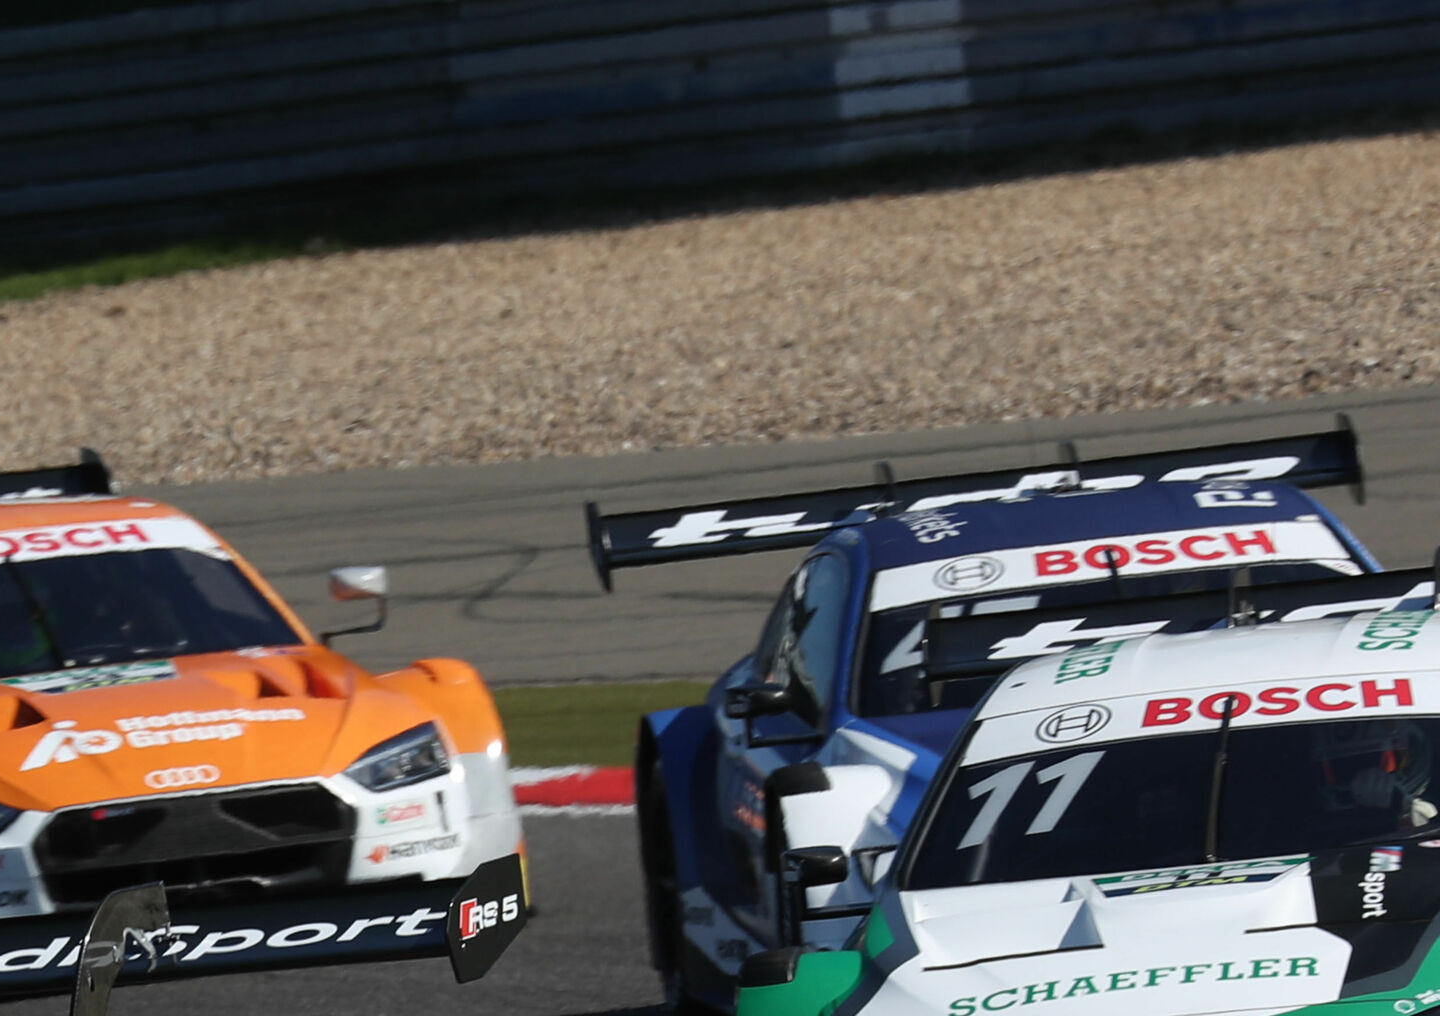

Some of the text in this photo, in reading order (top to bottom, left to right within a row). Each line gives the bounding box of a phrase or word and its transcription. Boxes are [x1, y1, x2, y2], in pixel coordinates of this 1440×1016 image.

[1034, 530, 1277, 577] BOSCH
[1141, 678, 1415, 729] BOSCH
[956, 750, 1108, 850] 11
[502, 893, 518, 922] 5
